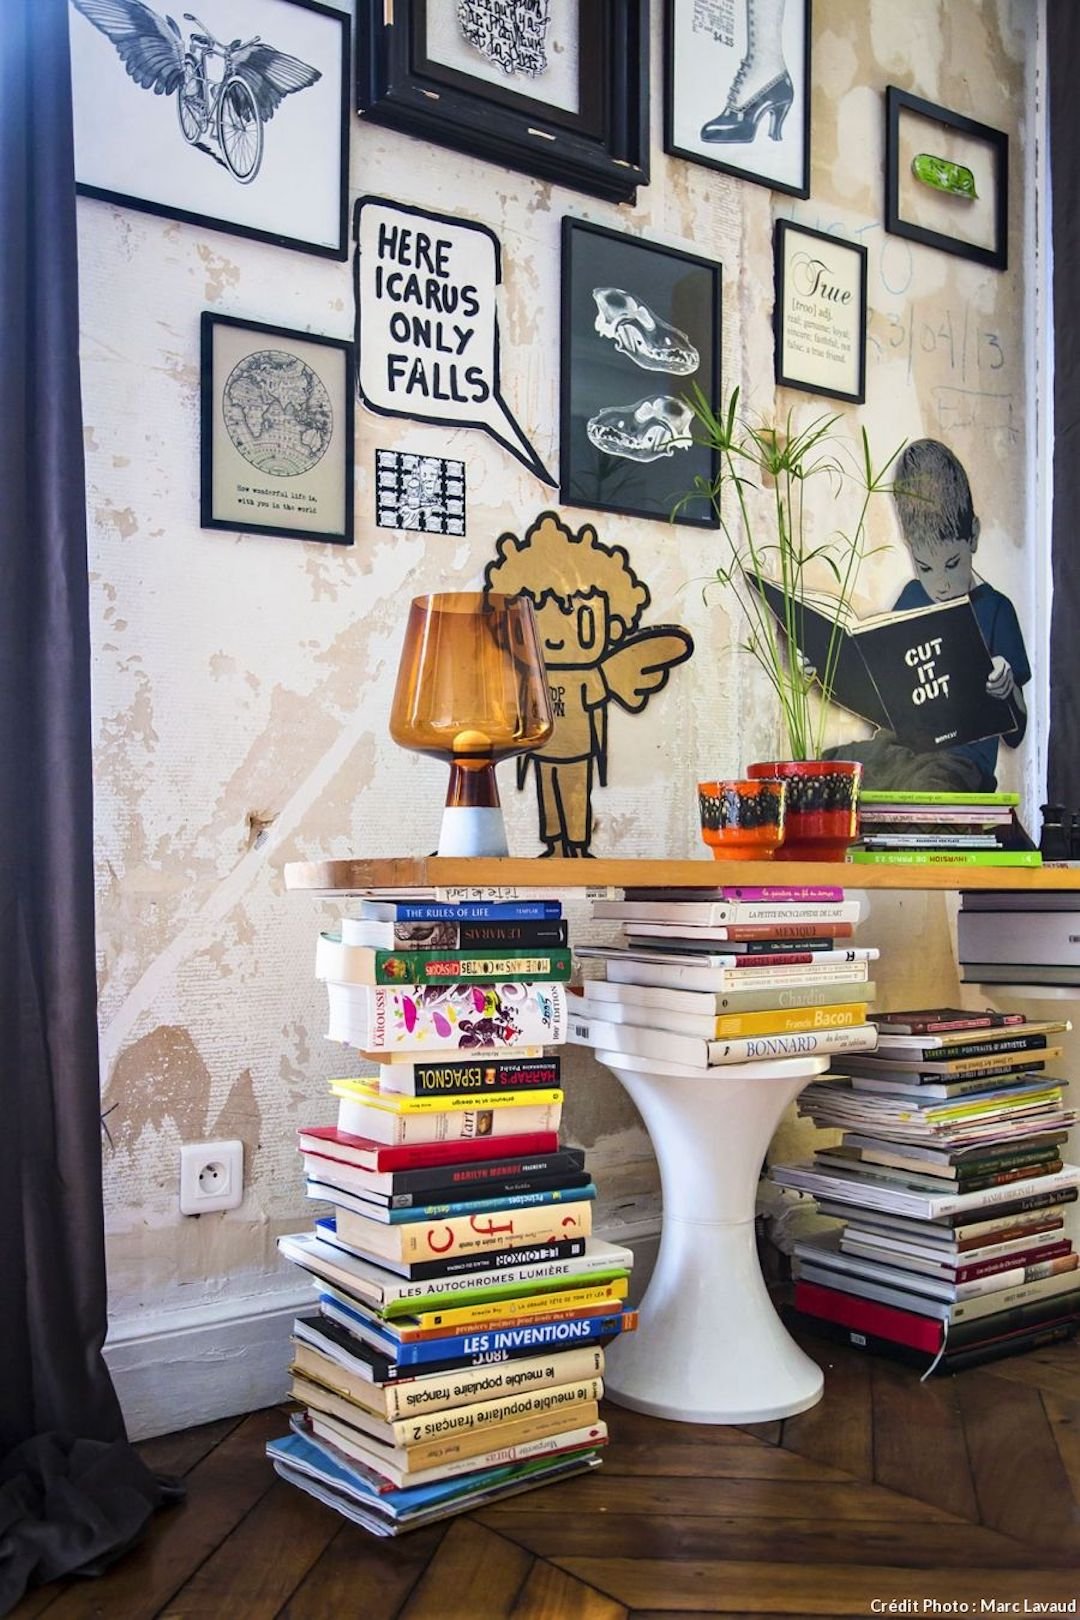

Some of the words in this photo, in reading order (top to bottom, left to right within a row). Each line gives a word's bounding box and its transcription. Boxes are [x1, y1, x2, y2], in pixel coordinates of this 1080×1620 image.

[378, 222, 453, 278] HERE
[790, 251, 852, 306] True
[375, 266, 480, 317] ICARUS
[389, 311, 475, 356] ONLY
[387, 353, 490, 403] FALLS
[904, 637, 943, 667] CUT
[917, 660, 936, 684] IT
[911, 674, 951, 706] OUT
[405, 909, 423, 918] THE
[426, 908, 455, 918] RULES
[456, 908, 469, 917] OF
[472, 907, 489, 917] LIFE
[778, 988, 826, 1007] Chardin
[375, 988, 387, 1048] LAROUSSE
[813, 1010, 854, 1027] Bacon
[746, 1035, 818, 1058] BONNARD
[418, 1067, 482, 1089] ESPAGNOL
[499, 1070, 556, 1085] HARRAP'S
[453, 1168, 488, 1183] MARILYN
[508, 1193, 545, 1205] Principes
[398, 1285, 422, 1299] LES
[427, 1272, 515, 1295] AUTOCHROMES
[518, 1264, 570, 1282] LUMIÈRE
[463, 1335, 490, 1354] LES
[494, 1320, 591, 1349] INVENTIONS
[453, 1373, 503, 1396] populaire
[505, 1369, 544, 1386] meuble
[545, 1367, 555, 1379] le
[406, 1380, 451, 1406] français
[534, 1390, 577, 1408] meuble
[577, 1388, 588, 1400] le
[424, 1409, 475, 1435] français
[477, 1399, 535, 1423] populaire
[412, 1425, 423, 1440] 2
[485, 1446, 517, 1463] Duras
